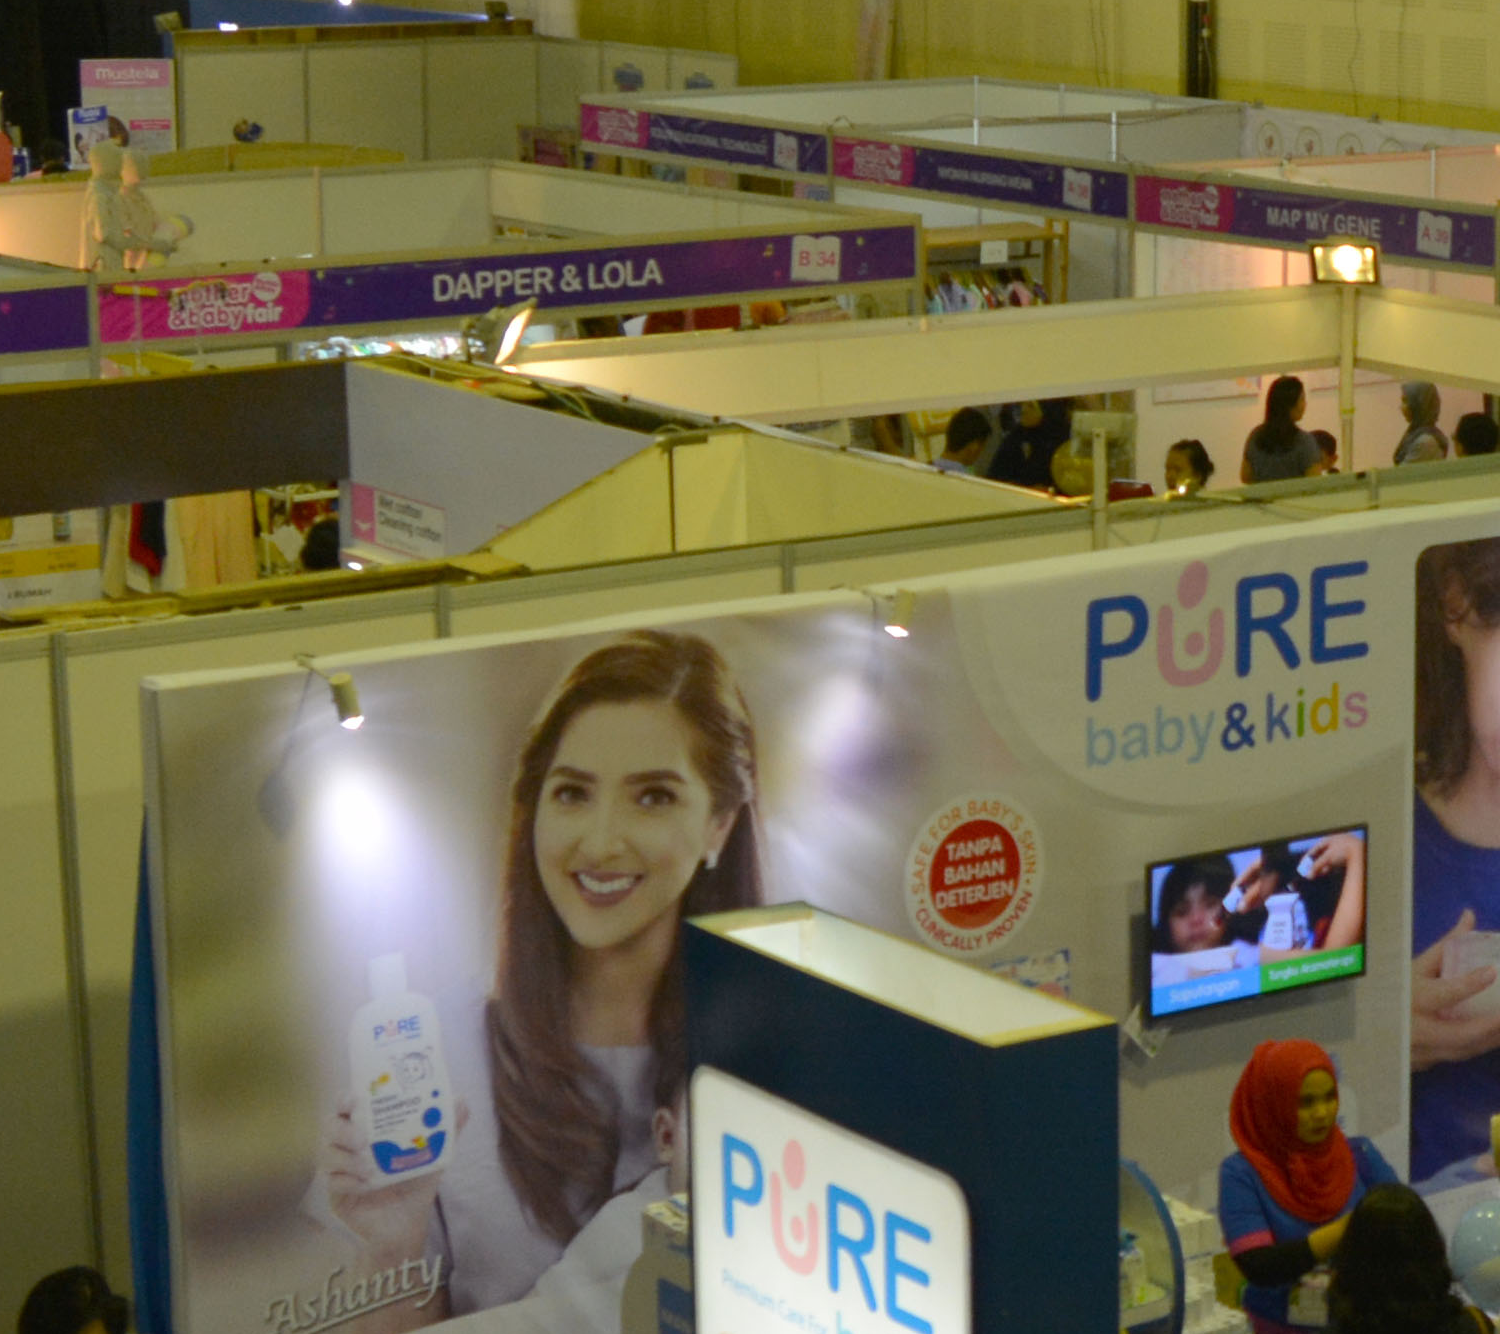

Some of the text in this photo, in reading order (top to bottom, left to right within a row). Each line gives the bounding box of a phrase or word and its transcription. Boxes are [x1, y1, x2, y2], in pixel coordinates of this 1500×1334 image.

[1265, 205, 1383, 238] MAP MY GENE
[432, 249, 838, 303] DAPPER & LOLA B 34
[169, 301, 283, 332] &baby fair
[1085, 560, 1369, 703] PURE
[928, 806, 962, 842] FOR
[945, 834, 1004, 862] TANPA
[943, 857, 1007, 885] BAHAN
[935, 878, 1015, 909] DETERJEN
